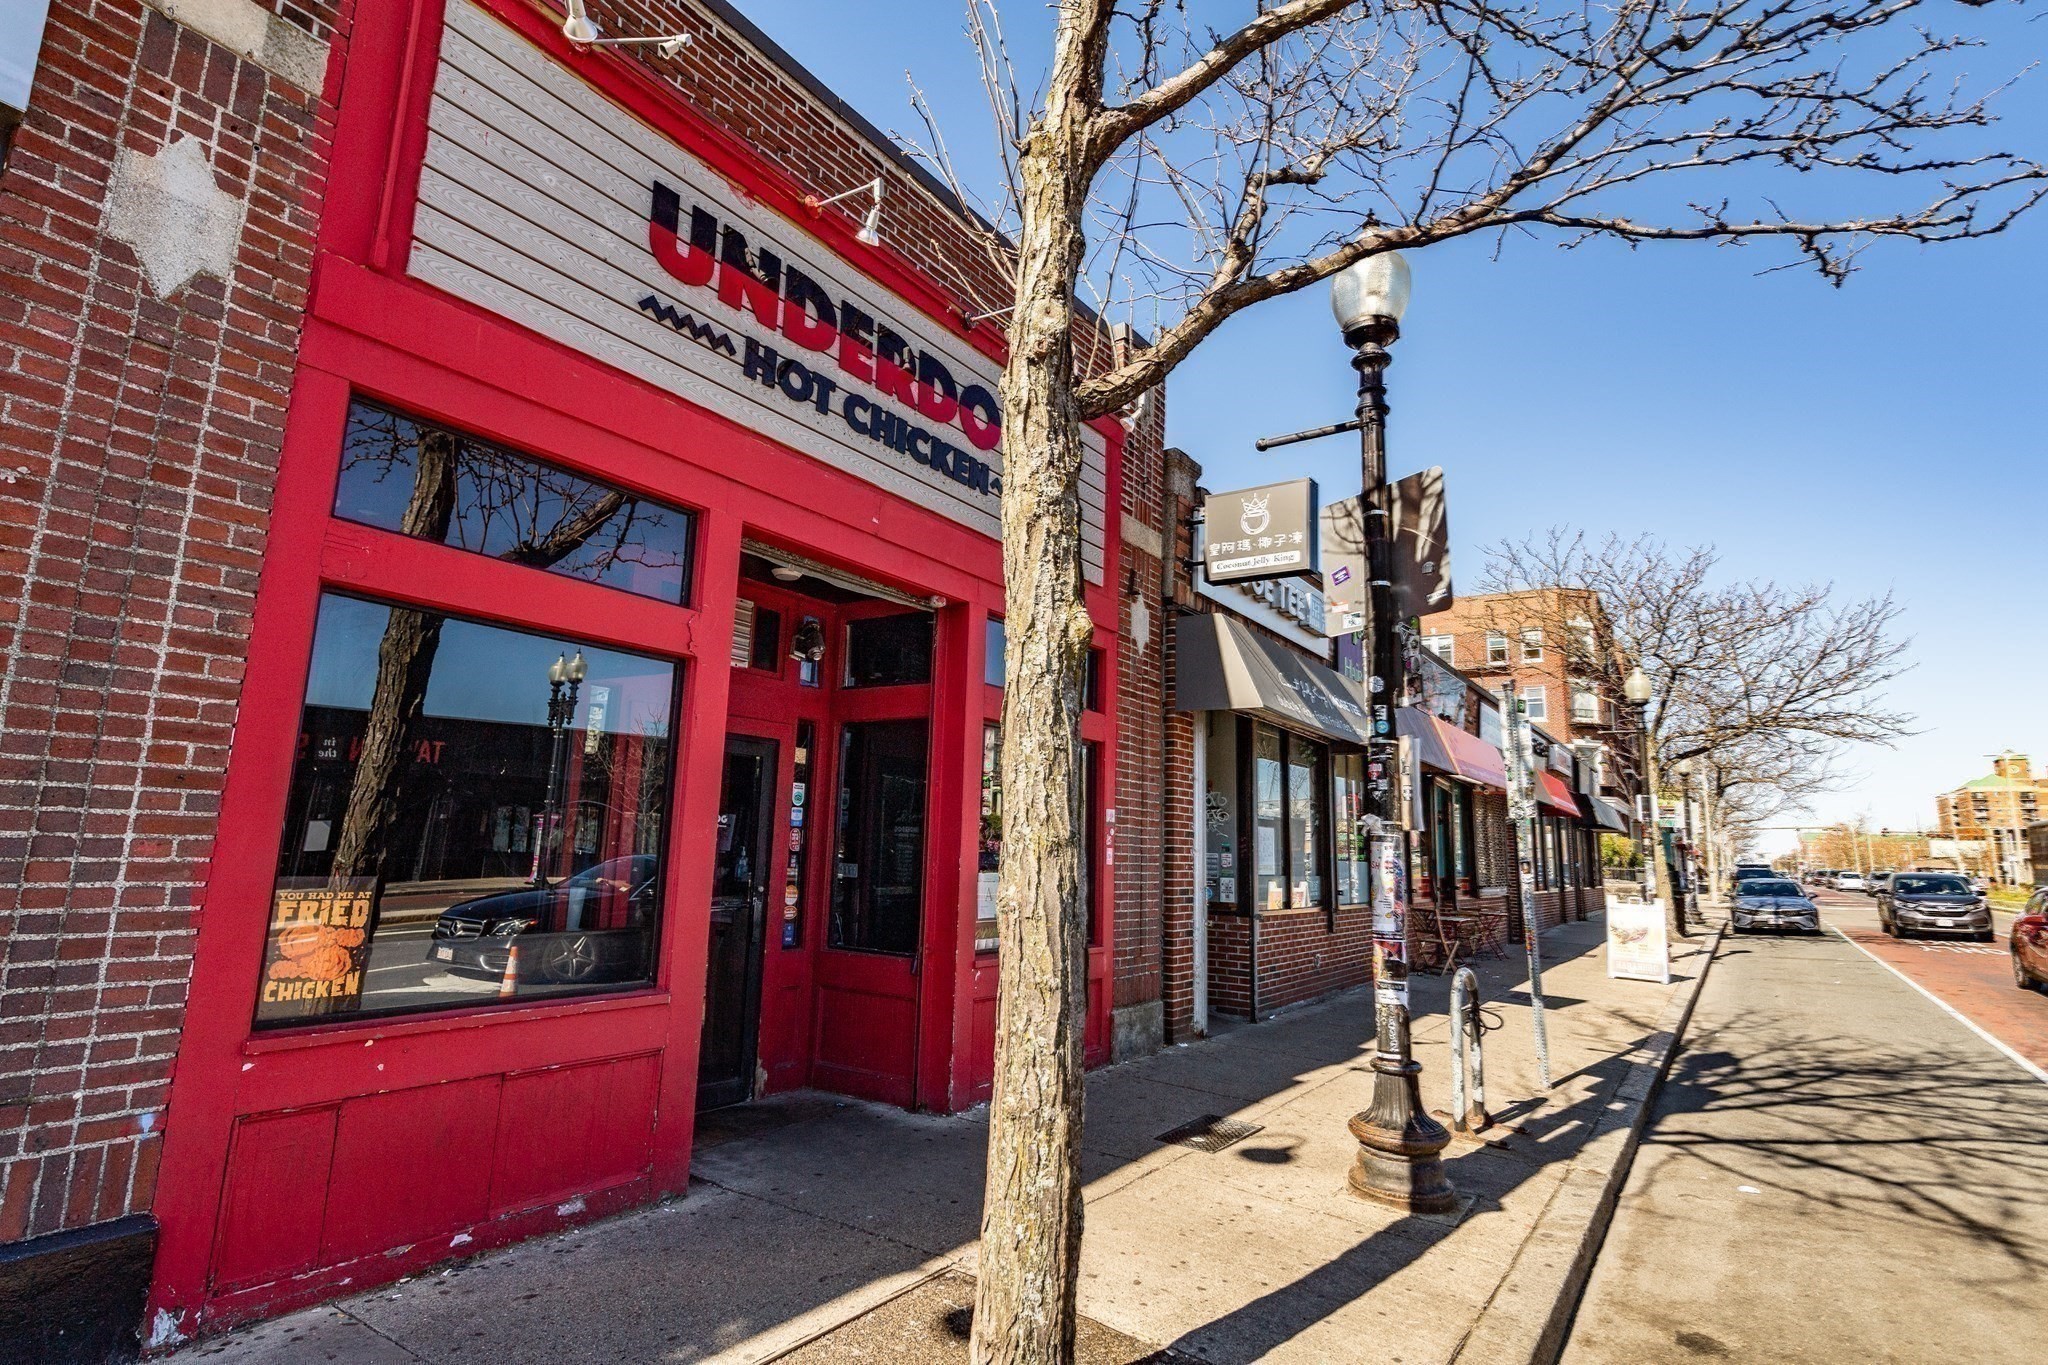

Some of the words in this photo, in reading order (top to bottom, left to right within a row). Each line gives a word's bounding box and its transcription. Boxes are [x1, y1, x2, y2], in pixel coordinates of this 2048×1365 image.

[649, 180, 1001, 450] UNDERDO
[743, 336, 836, 415] HOT
[843, 394, 990, 495] CHICKEN
[1216, 560, 1251, 571] Coconut
[1252, 556, 1269, 566] Jelly
[1273, 553, 1295, 563] King
[276, 900, 370, 928] FRIED
[263, 970, 361, 1002] CHICKEN
